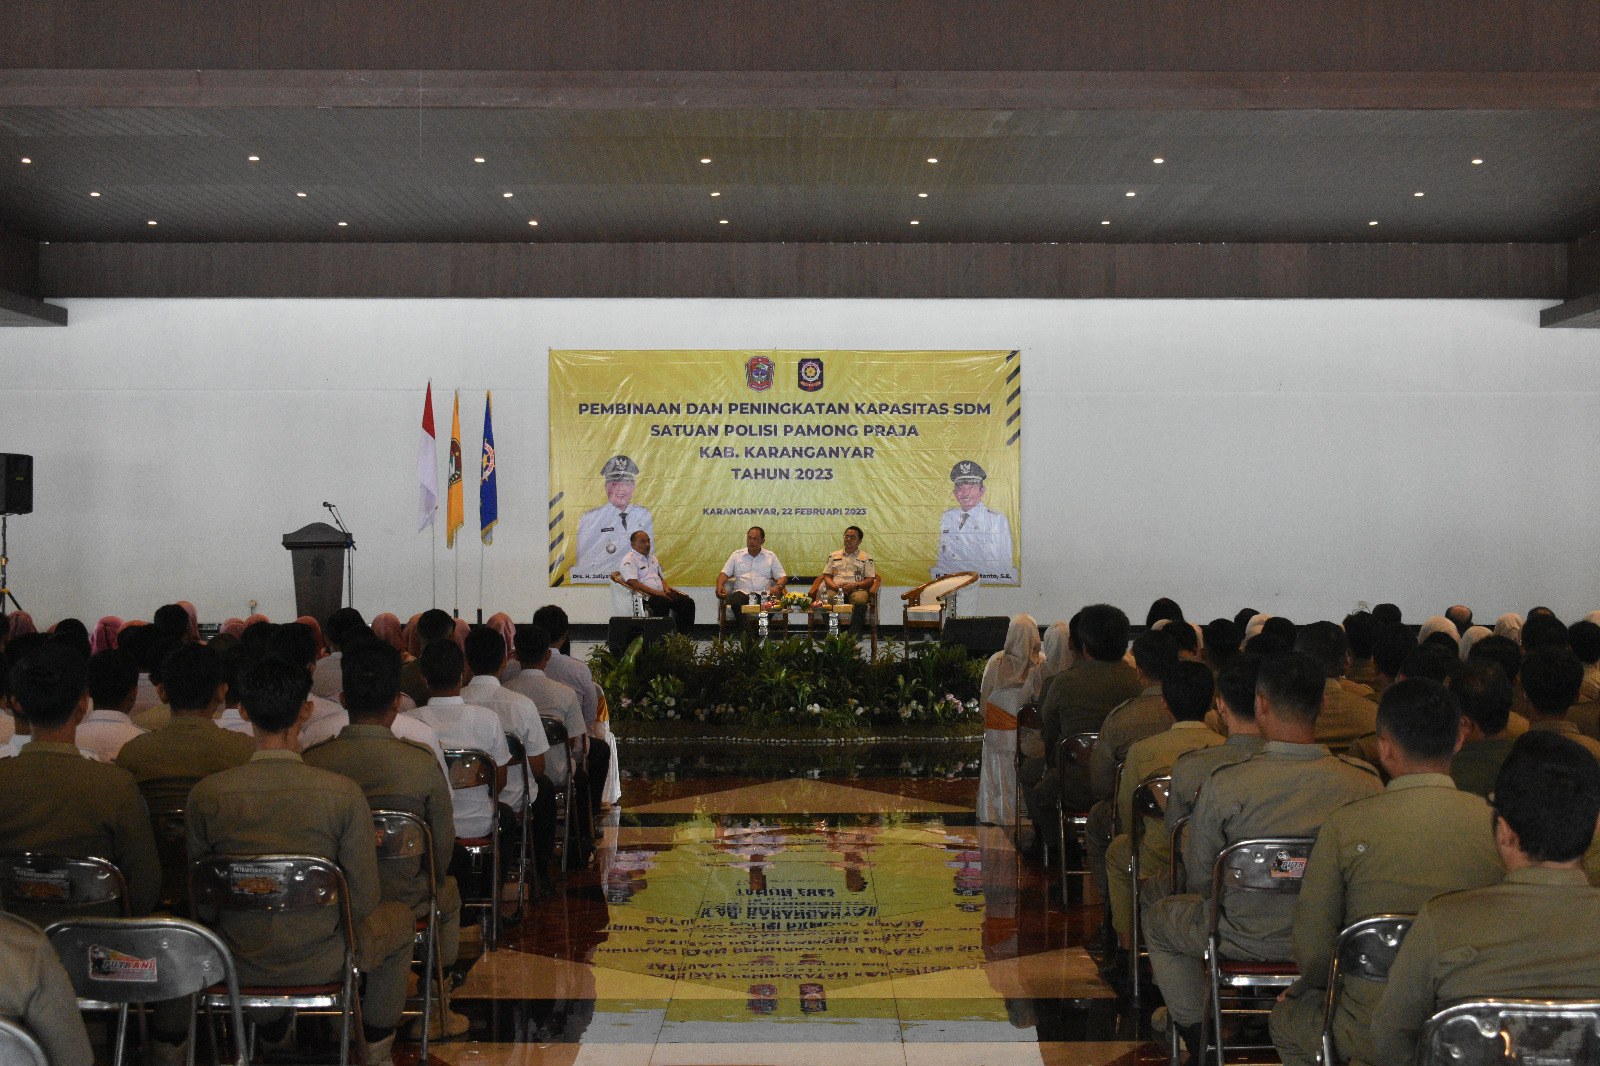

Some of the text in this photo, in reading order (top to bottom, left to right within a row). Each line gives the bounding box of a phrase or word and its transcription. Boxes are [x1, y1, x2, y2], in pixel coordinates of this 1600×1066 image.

[579, 403, 990, 415] PEMBINAAN DAN PENINGKATAN KAPASITAS SDM
[651, 425, 919, 436] SATUAN POLISI PAMONG PRAJA
[699, 446, 875, 458] KAB. KARANGANYAR
[731, 469, 834, 480] TAHUN 2023
[703, 507, 866, 517] KARANGANYAR, 22 FEBRUARI 2023
